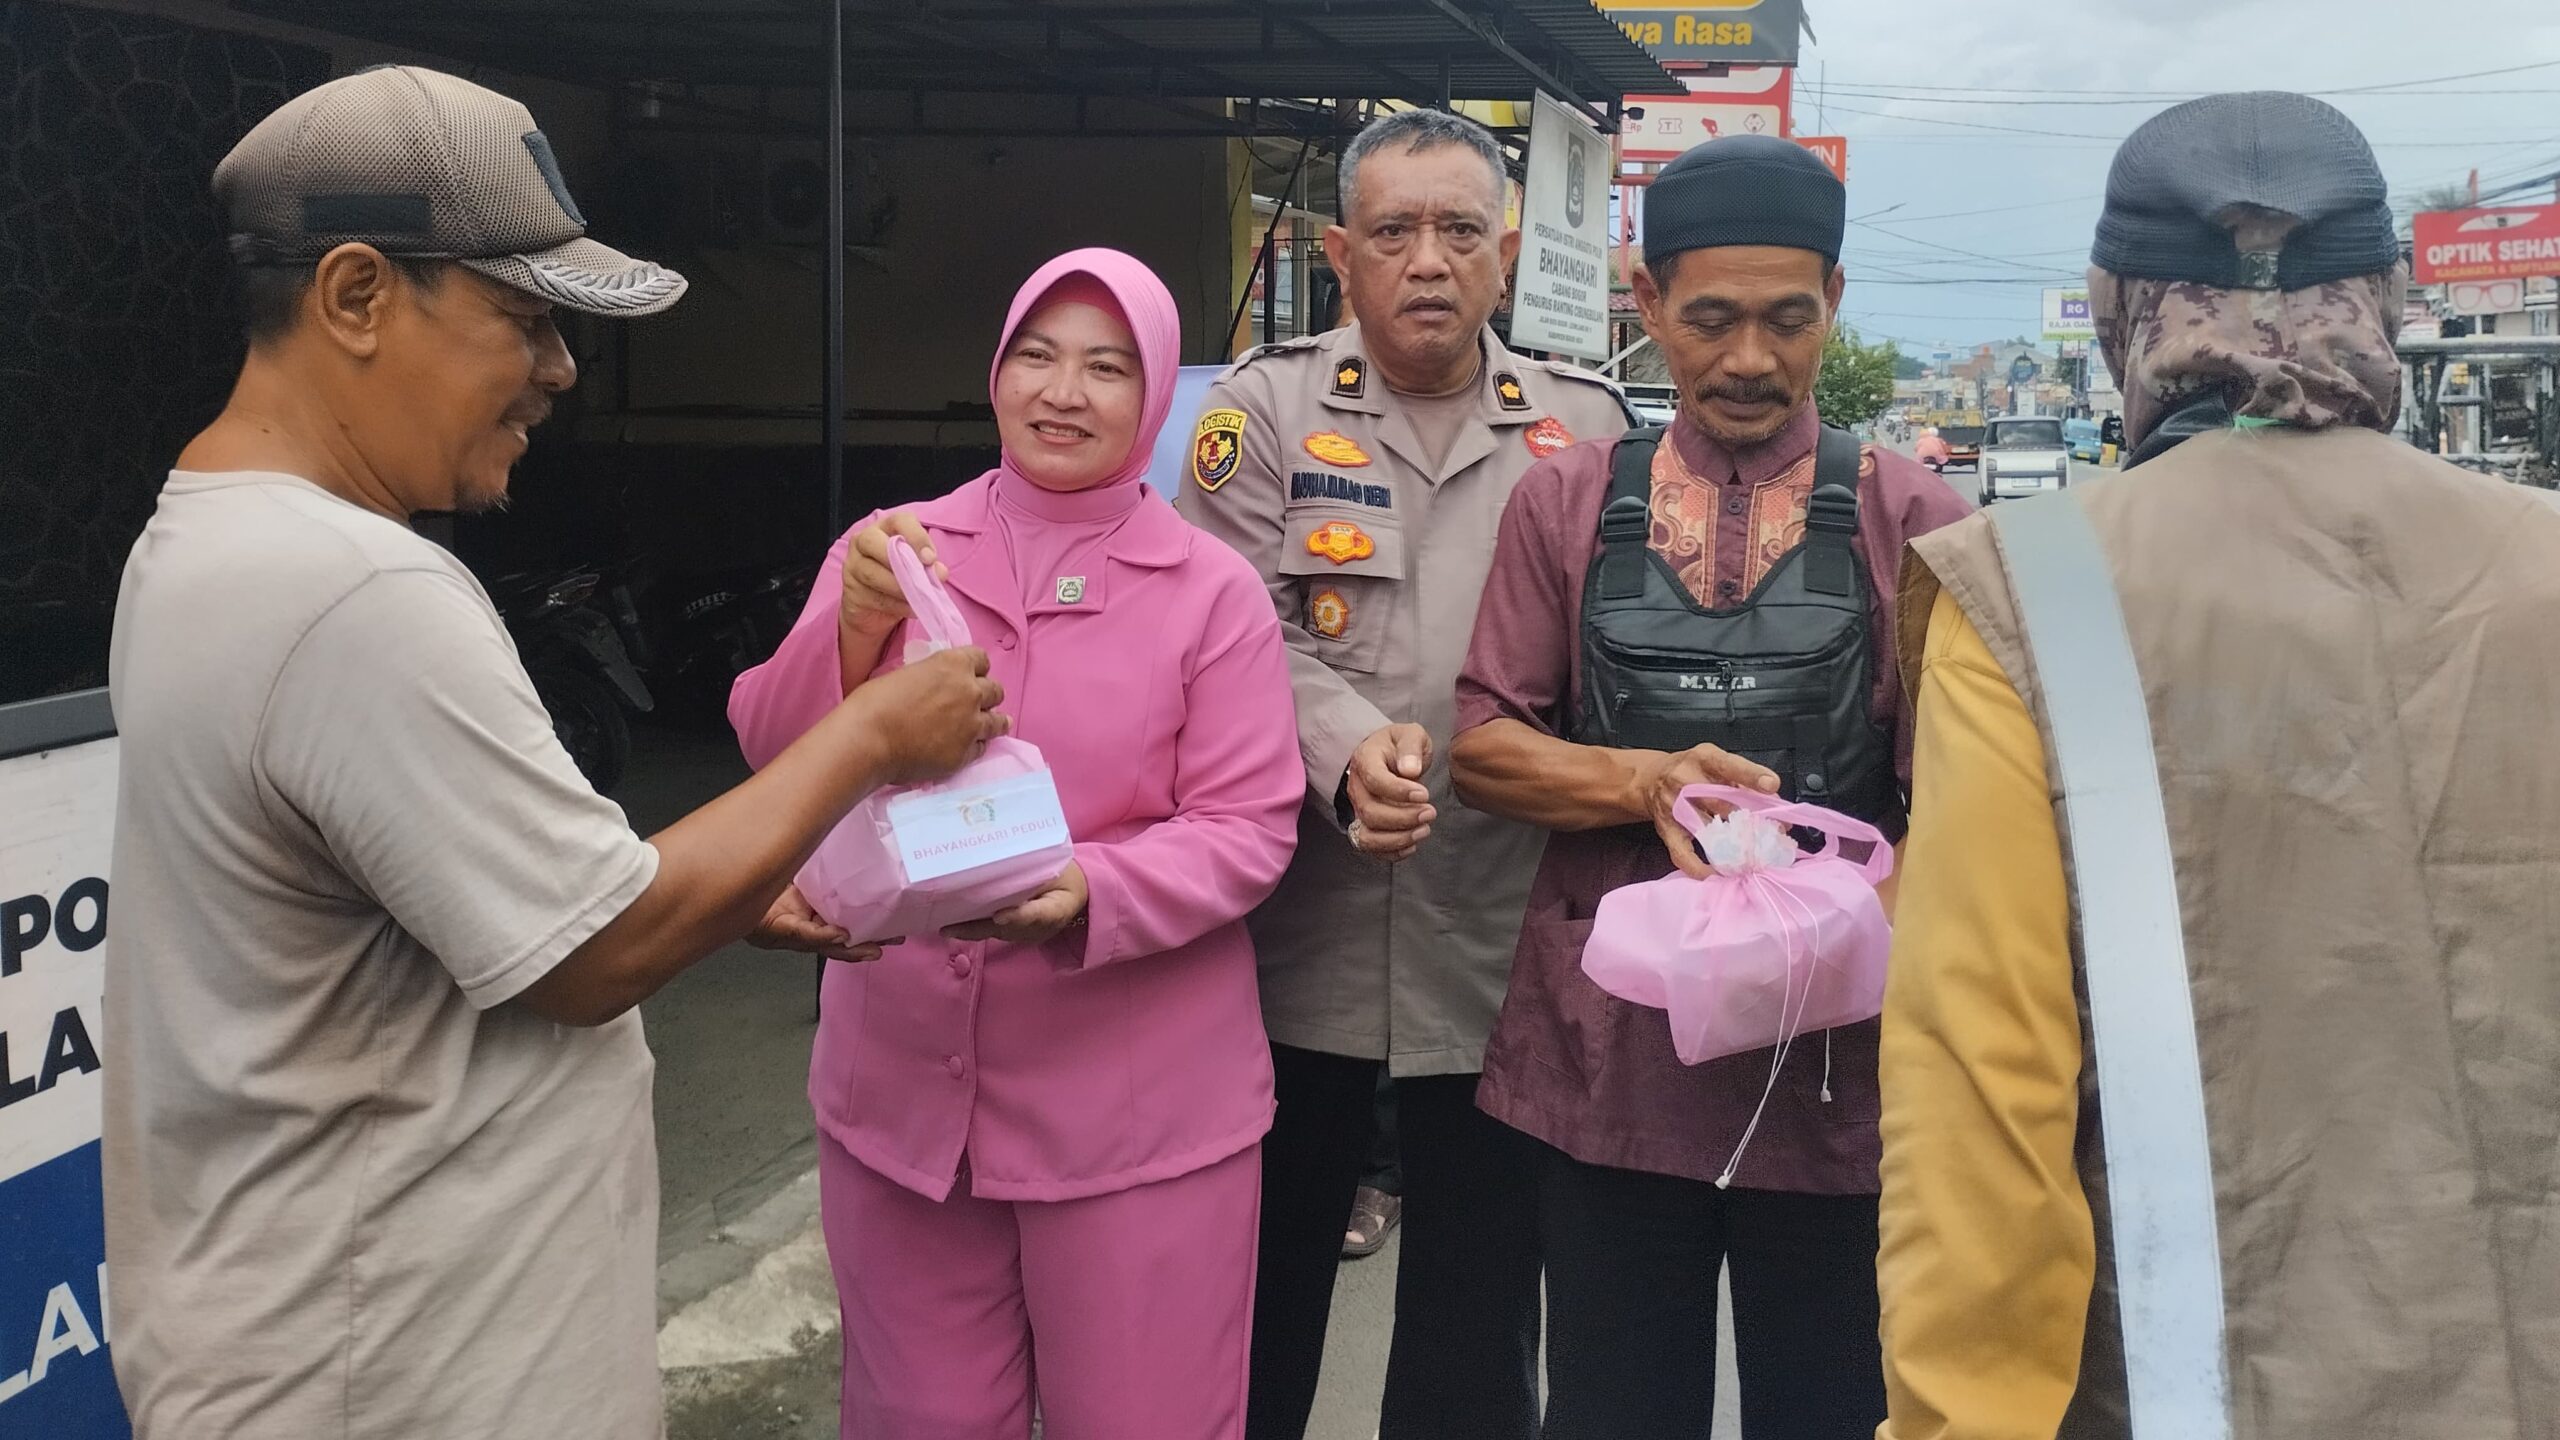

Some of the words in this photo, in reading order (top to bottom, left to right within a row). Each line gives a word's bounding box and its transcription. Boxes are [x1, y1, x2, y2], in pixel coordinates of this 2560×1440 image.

[1674, 15, 1753, 45] Rasa
[2426, 241, 2494, 266] OPTIK
[2498, 236, 2560, 261] SEHAT
[1539, 247, 1598, 289] BHAYANGKARI
[1523, 292, 1552, 311] PENGURUS
[1552, 281, 1571, 299] CABANG
[2066, 303, 2085, 314] RG
[1291, 472, 1362, 503] MUHAMMAD
[913, 829, 1009, 860] BHAYANGKARI
[1013, 817, 1057, 839] PEDULI
